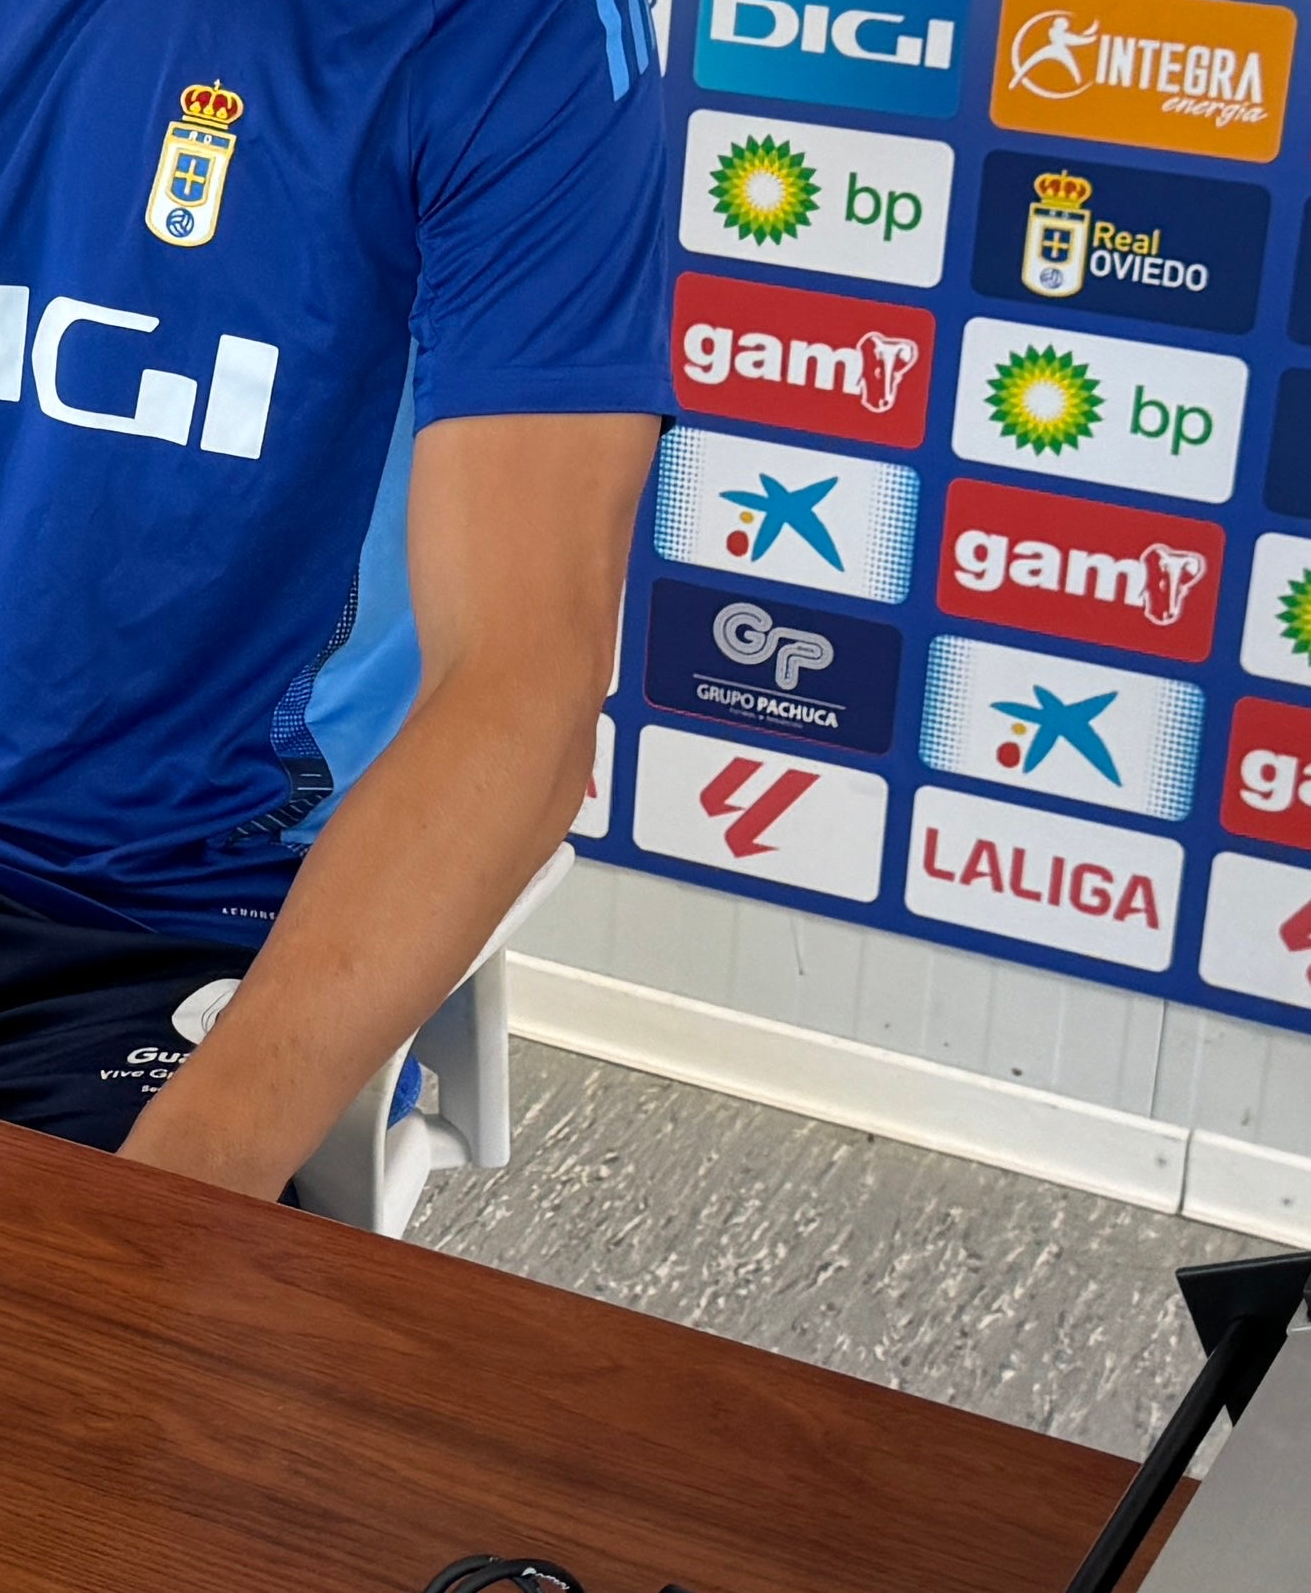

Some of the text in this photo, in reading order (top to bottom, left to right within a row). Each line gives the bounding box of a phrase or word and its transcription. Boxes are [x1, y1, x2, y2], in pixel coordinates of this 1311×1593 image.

[1095, 33, 1263, 105] INTEGRA
[845, 171, 922, 242] bp
[1093, 221, 1161, 256] Real
[1089, 249, 1209, 293] OVIEDO
[683, 322, 863, 395] gam
[1130, 385, 1212, 456] bp
[953, 528, 1147, 606] gam
[696, 682, 755, 710] GRUPO
[757, 696, 838, 729] PACHUCA
[921, 827, 1160, 930] LALIGA
